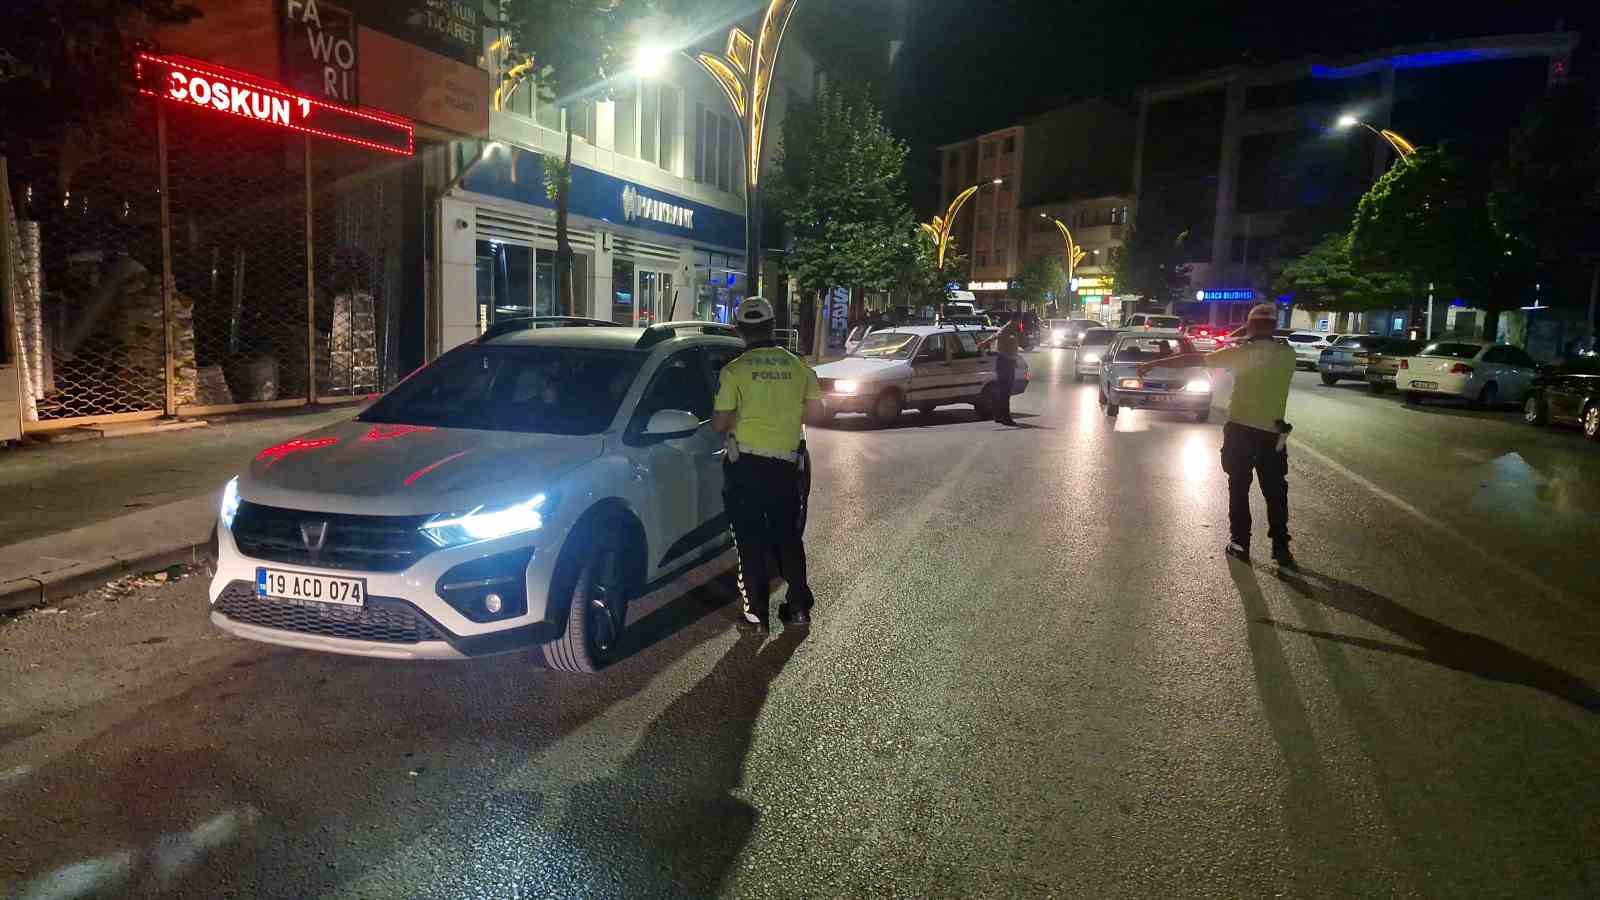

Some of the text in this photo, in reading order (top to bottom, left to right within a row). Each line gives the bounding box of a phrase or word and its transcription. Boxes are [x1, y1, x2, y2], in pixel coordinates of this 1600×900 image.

[268, 573, 361, 603] 19 ACD 074
